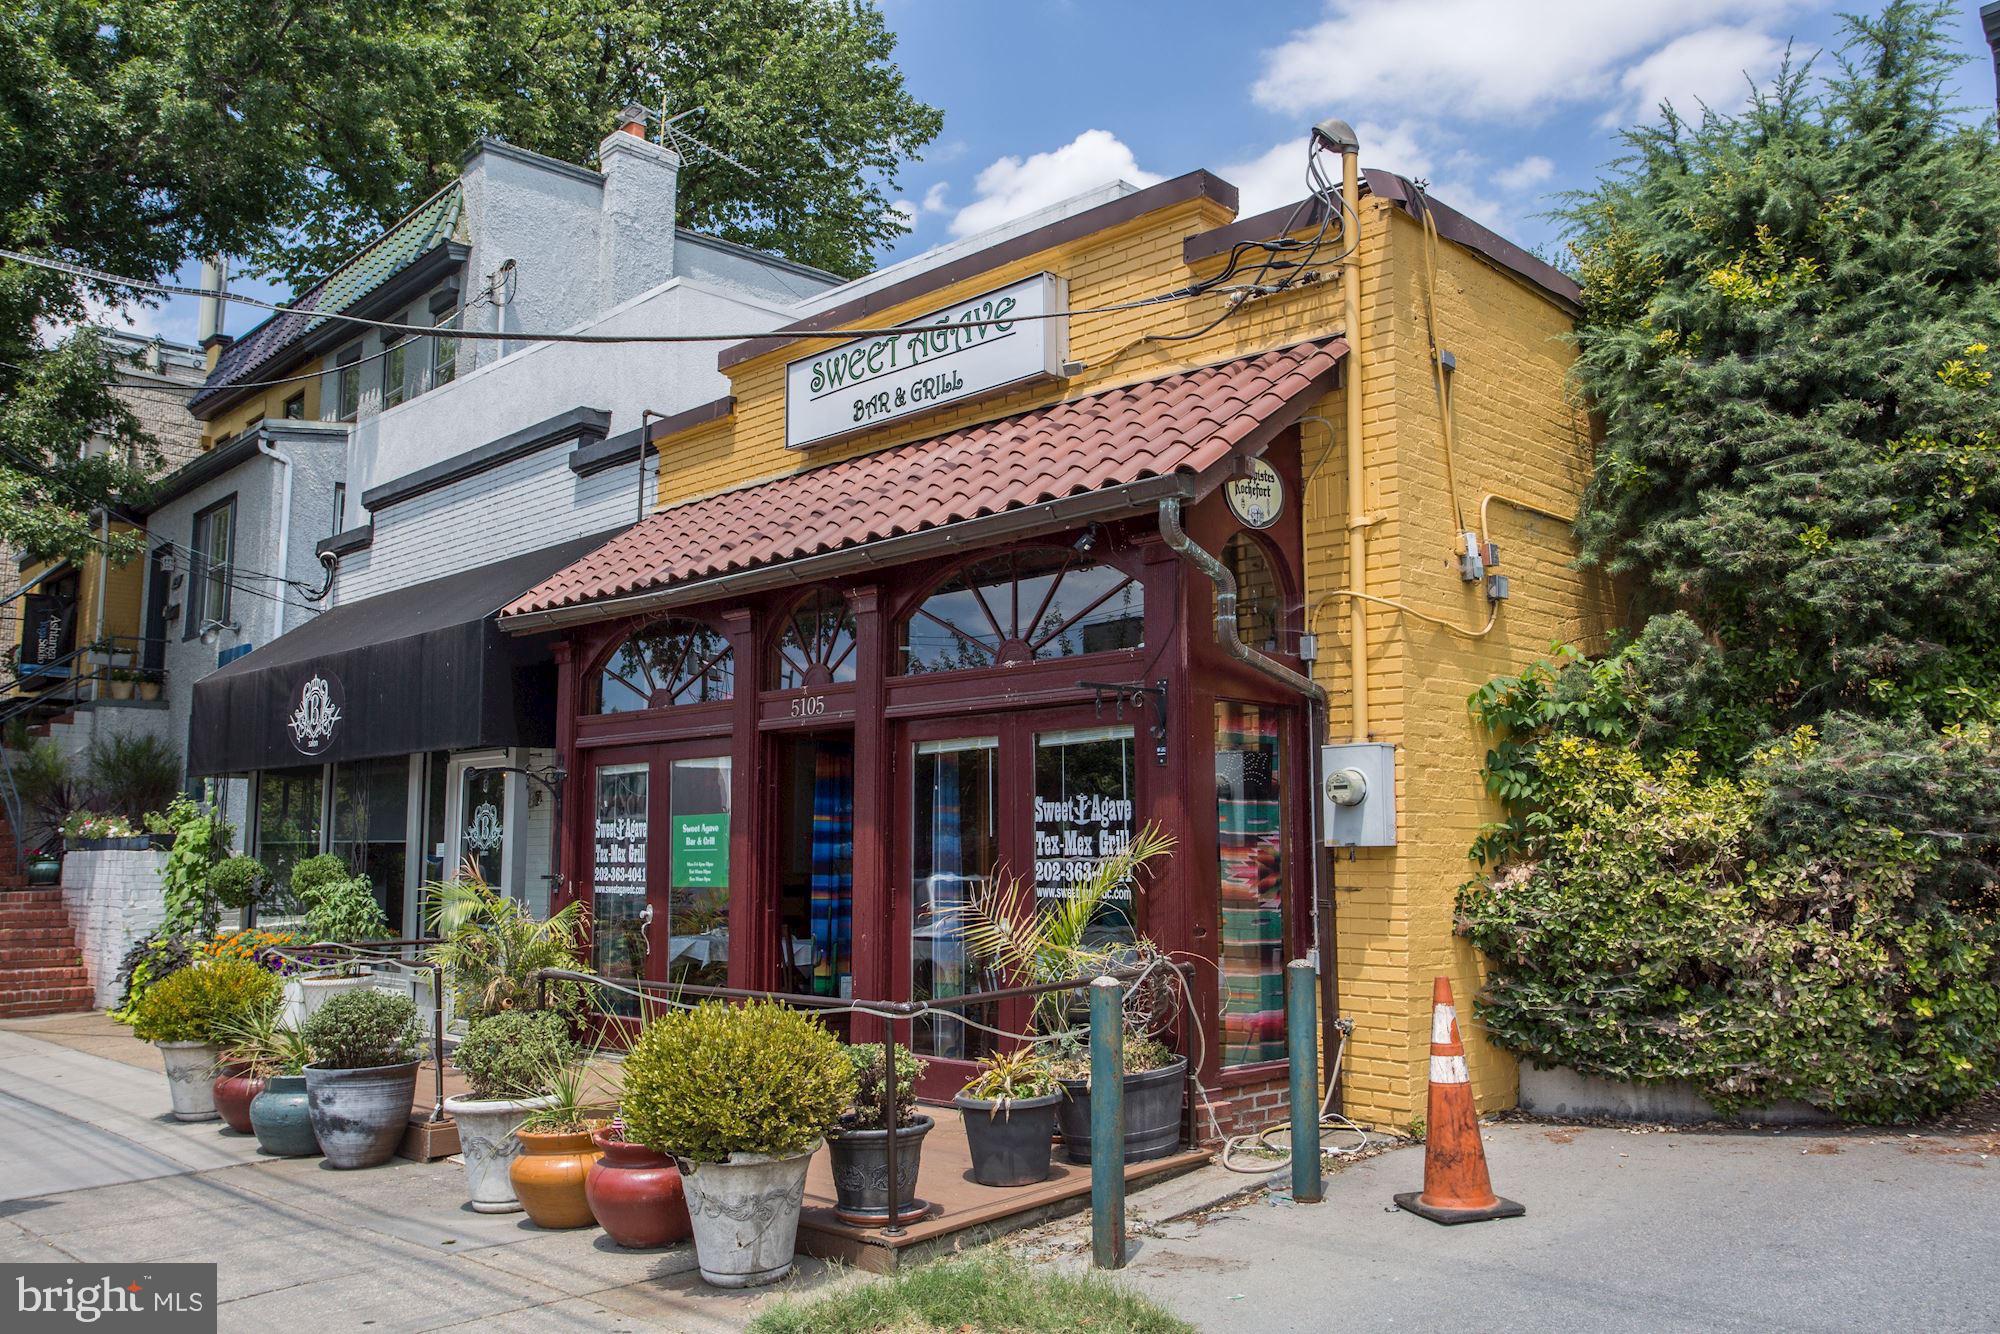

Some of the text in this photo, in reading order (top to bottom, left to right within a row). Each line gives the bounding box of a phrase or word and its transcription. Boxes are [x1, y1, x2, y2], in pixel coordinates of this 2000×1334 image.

[811, 297, 1016, 393] SWEET AGAVE
[853, 370, 963, 422] BAR & GRILL
[791, 696, 825, 718] 5105
[1035, 794, 1132, 828] Sweet Agave
[595, 817, 647, 842] Sweet Agave
[685, 836, 696, 846] Bar
[703, 836, 716, 846] Grill
[596, 843, 646, 863] Tex-Mex Grill
[1036, 830, 1130, 856] Tex-Mex Grill
[594, 867, 646, 882] 202-363-4041
